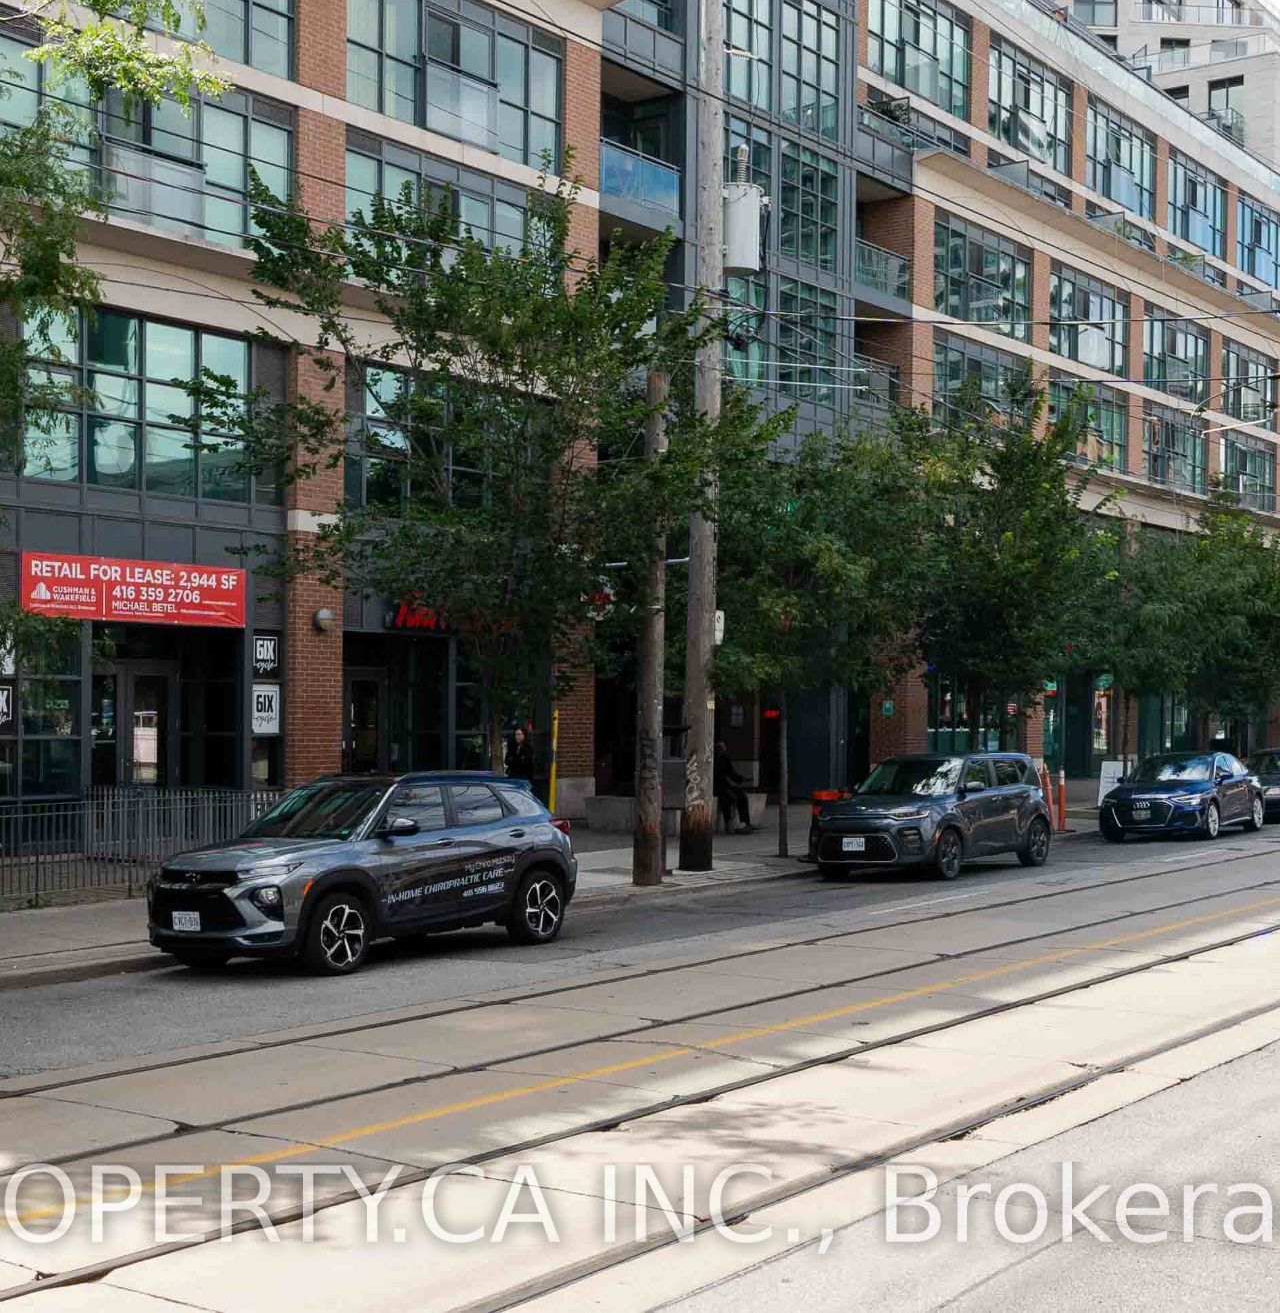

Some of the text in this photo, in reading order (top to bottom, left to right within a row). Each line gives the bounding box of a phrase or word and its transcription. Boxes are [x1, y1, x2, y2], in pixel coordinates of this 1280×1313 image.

[31, 560, 238, 590] RETAIL FOR LEASE: 2,944 SF
[52, 586, 89, 595] CUSHMAN
[112, 586, 136, 599] 416
[140, 588, 164, 601] 359
[169, 589, 201, 603] 2706
[52, 593, 96, 603] WAKEFIELD
[112, 601, 148, 611] MICHAEL
[152, 603, 178, 613] BETEL
[387, 868, 505, 904] IN-HOME CHIROPRACTIC CARE
